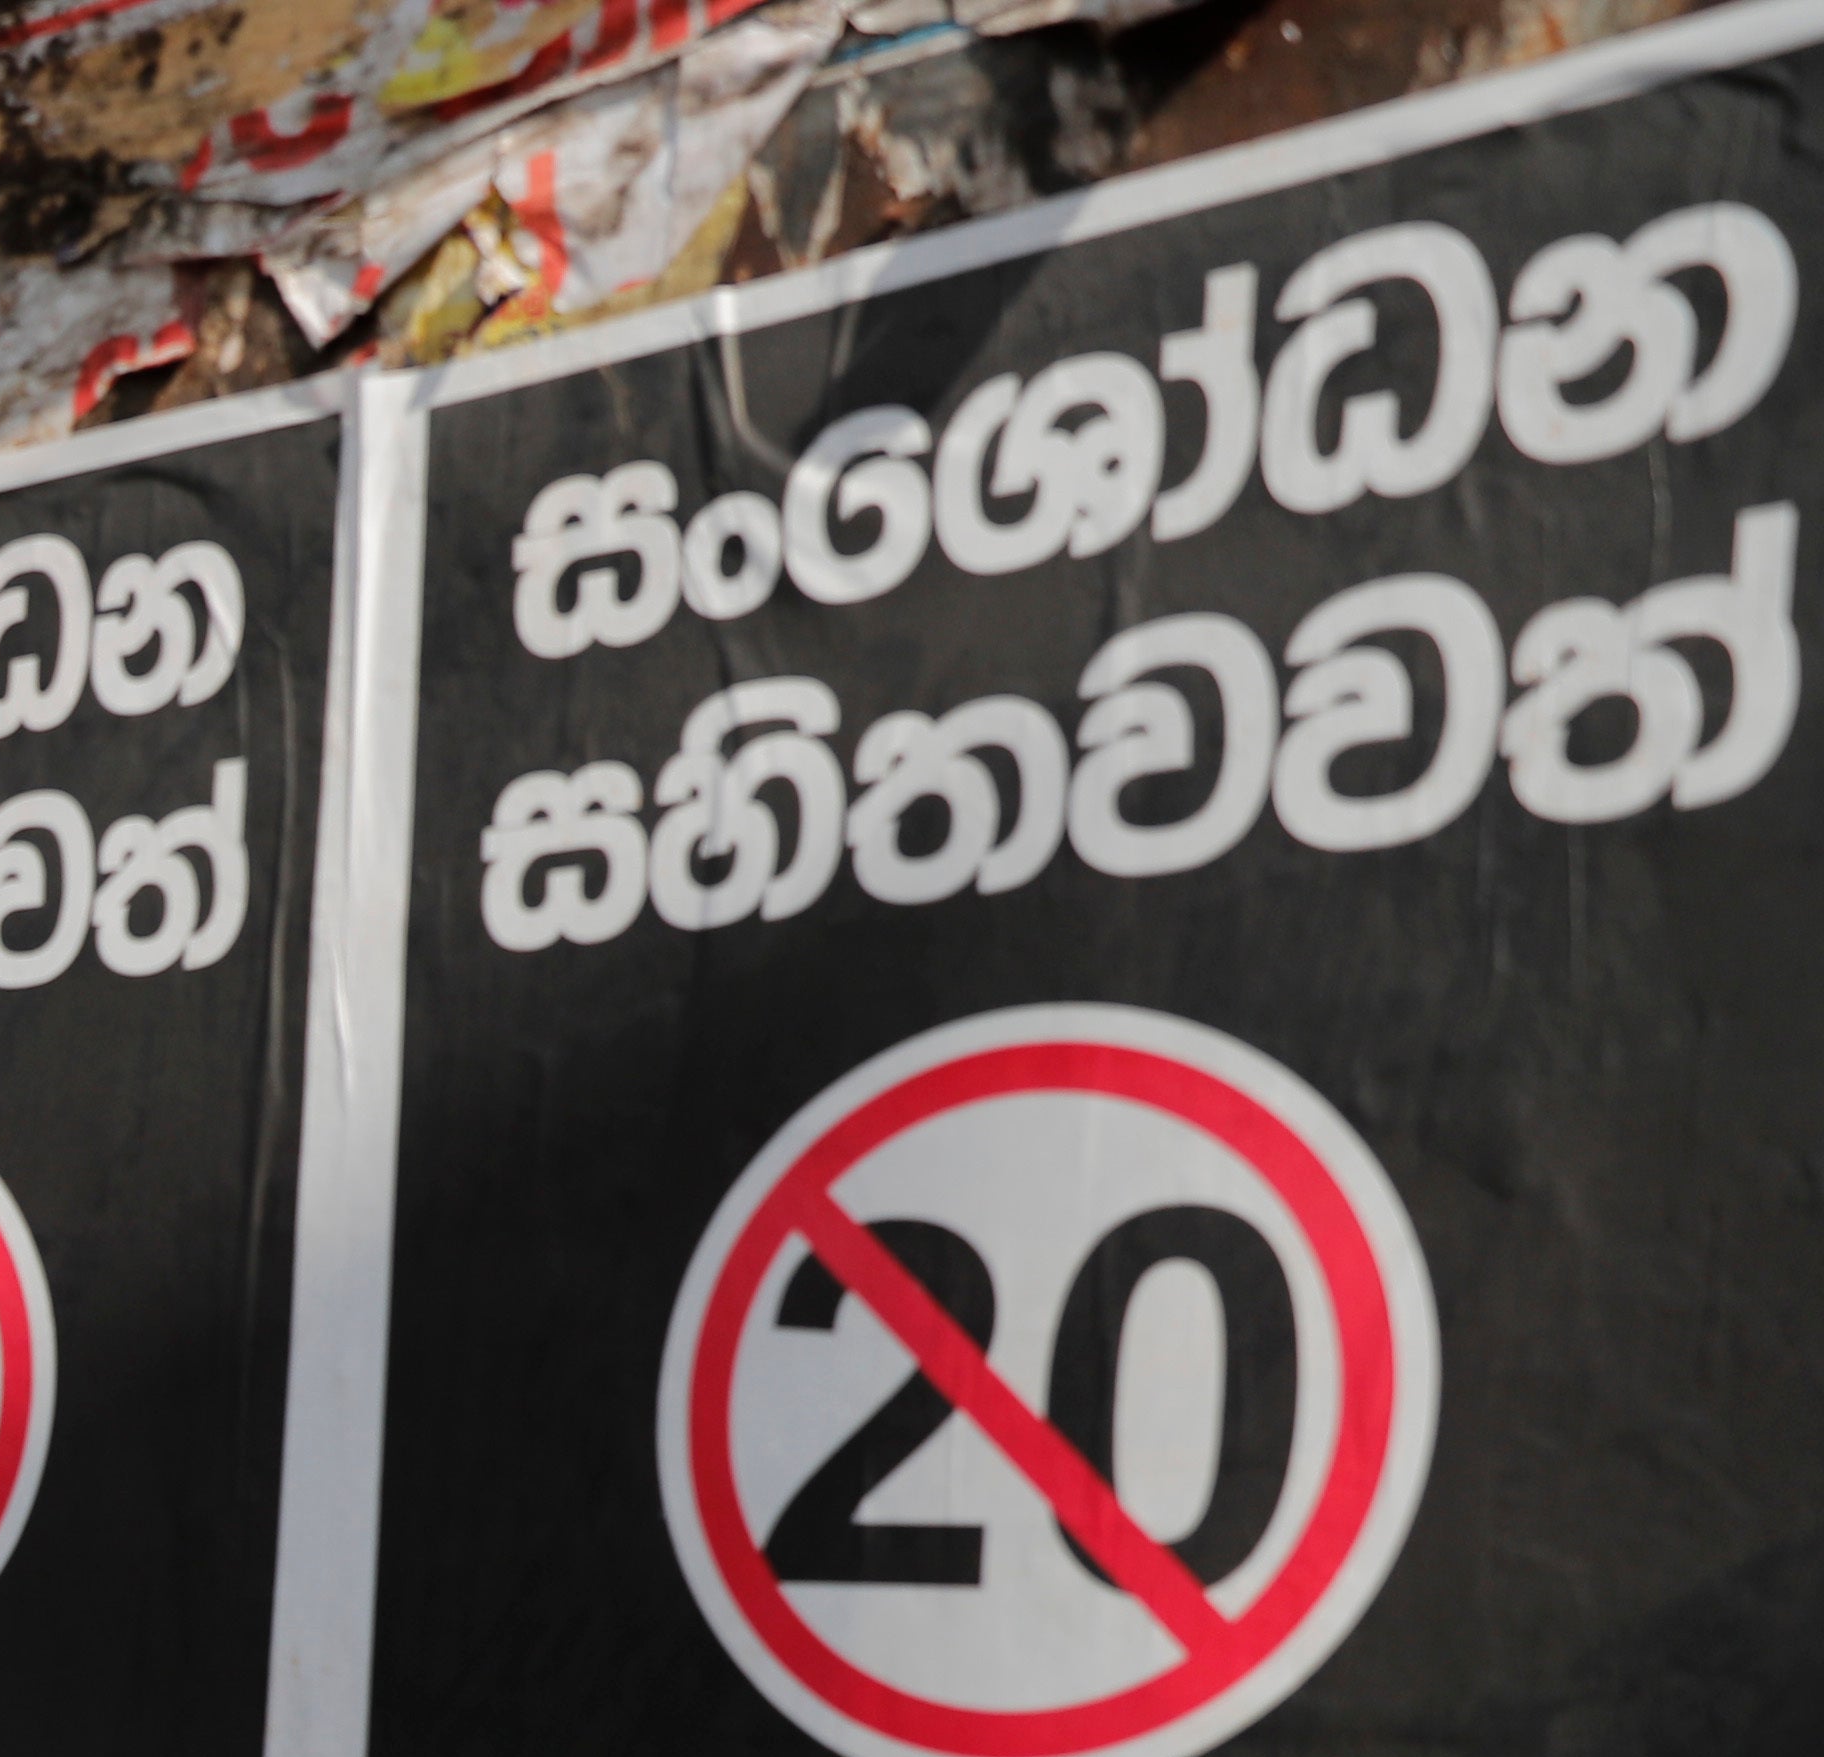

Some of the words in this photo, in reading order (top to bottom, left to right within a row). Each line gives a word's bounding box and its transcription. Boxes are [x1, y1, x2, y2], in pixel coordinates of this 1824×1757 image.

[510, 200, 1799, 659] සංශෝධන
[479, 500, 1802, 953] සහිතවවත්
[759, 1200, 1299, 1597] 20
